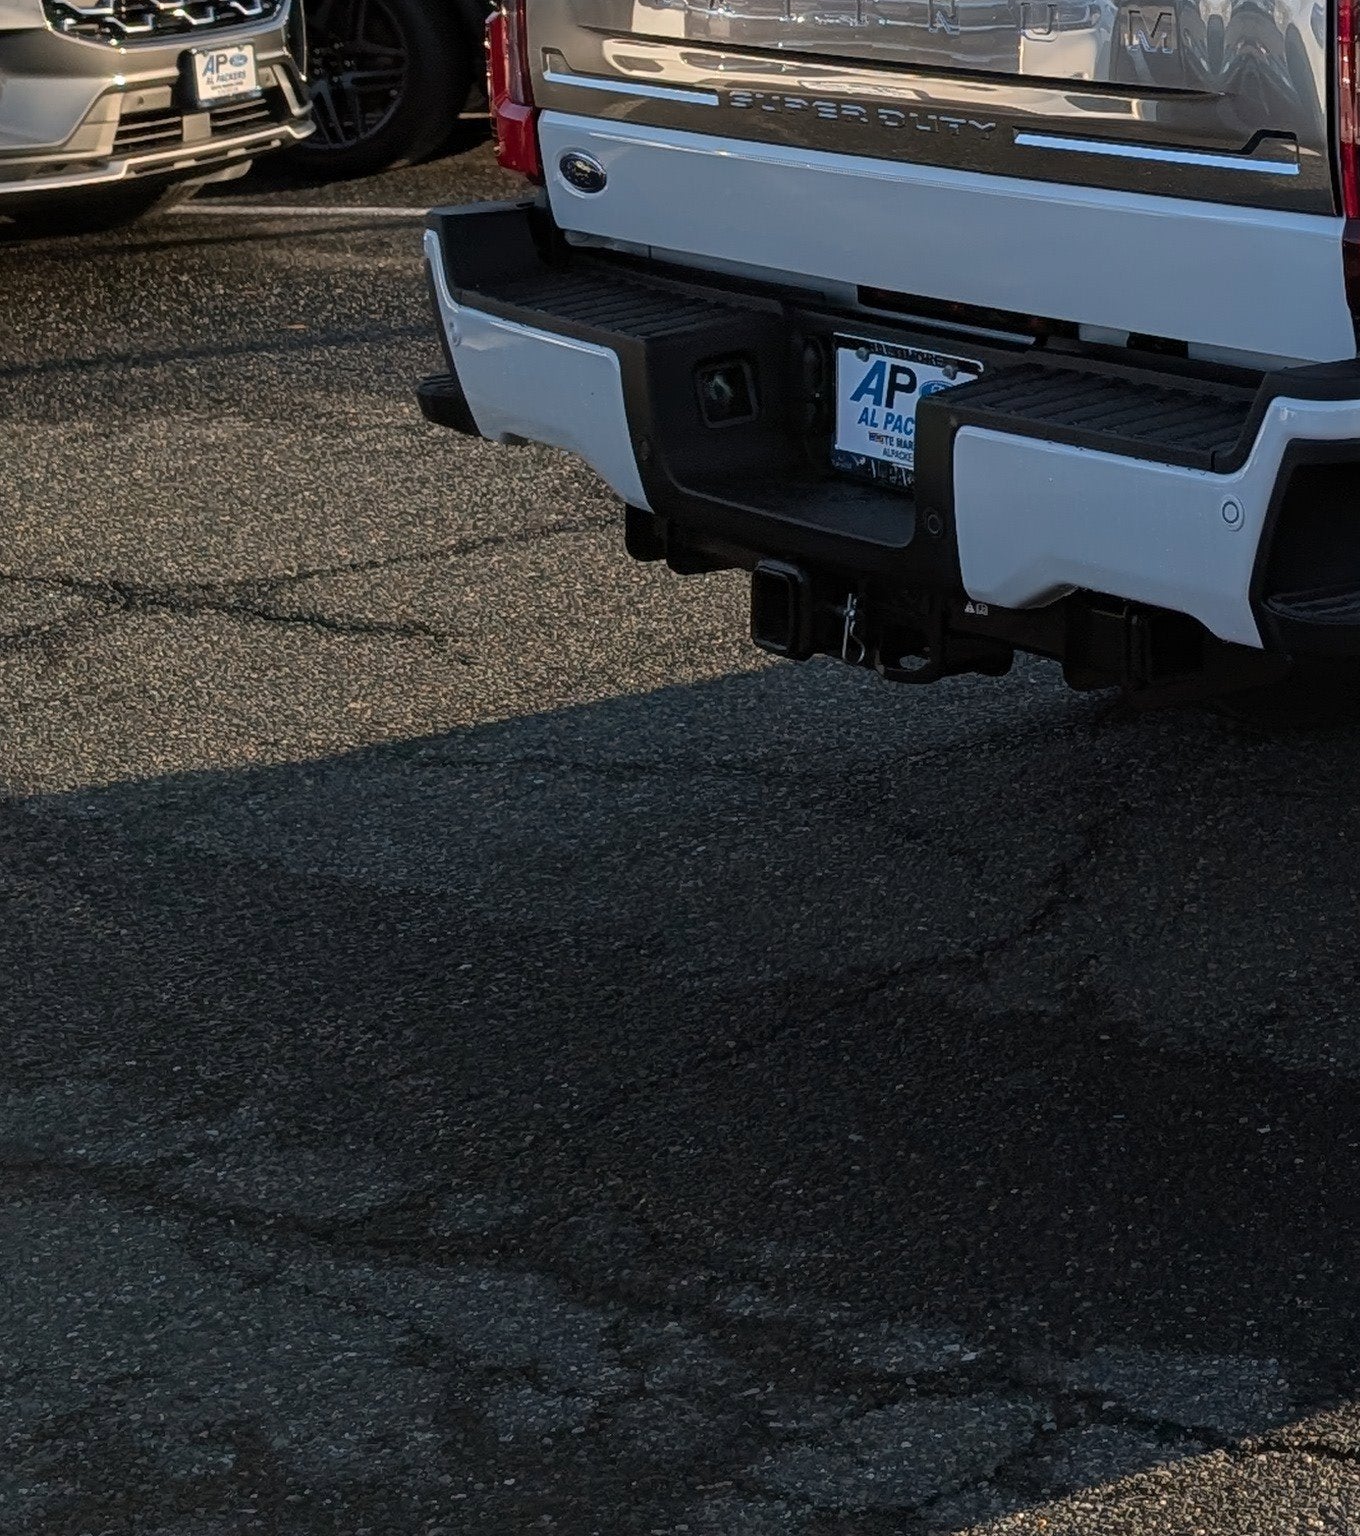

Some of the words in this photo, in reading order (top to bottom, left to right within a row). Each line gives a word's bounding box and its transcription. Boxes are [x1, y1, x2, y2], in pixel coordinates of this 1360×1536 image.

[202, 54, 228, 77] AP
[729, 90, 868, 123] SUPER
[876, 108, 996, 140] DUTY
[850, 360, 917, 409] AP
[857, 406, 879, 428] AL
